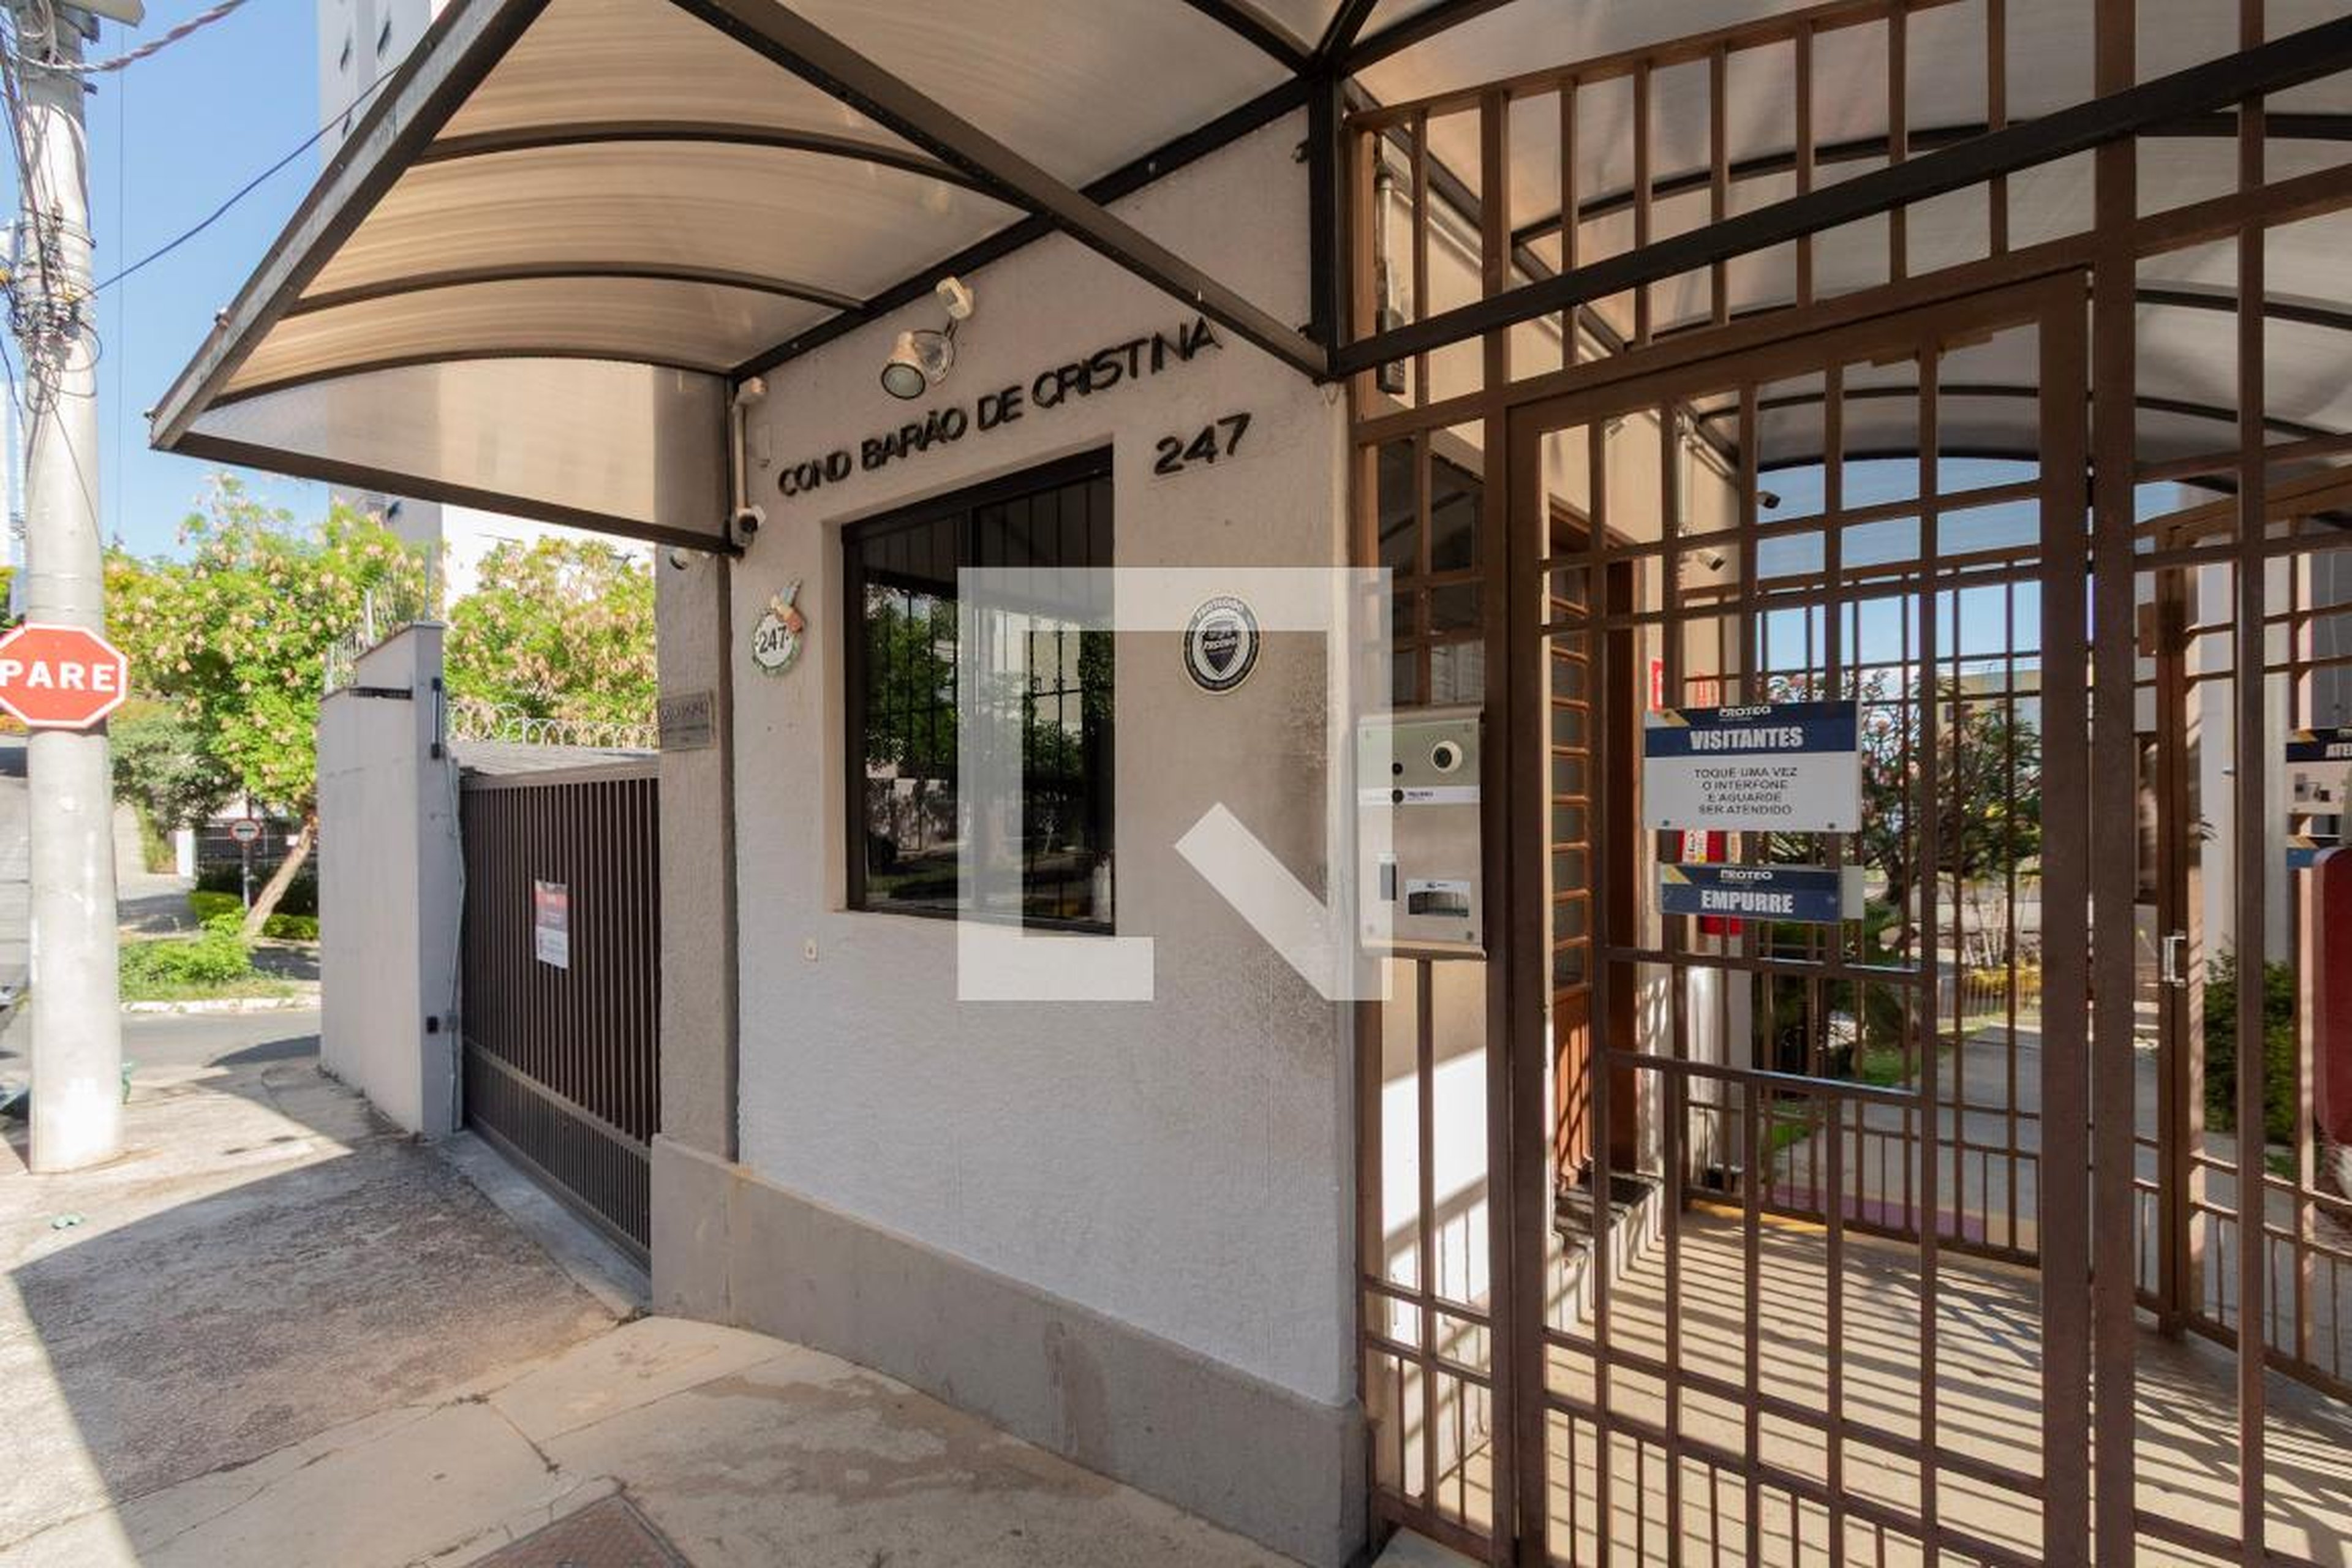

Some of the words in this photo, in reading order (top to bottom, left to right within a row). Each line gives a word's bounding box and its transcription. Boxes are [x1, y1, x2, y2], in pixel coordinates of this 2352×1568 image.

[777, 450, 852, 497] COND
[861, 407, 969, 470] BARÃO
[977, 385, 1023, 431] DE
[1031, 316, 1223, 409] CRISTINA
[1154, 412, 1251, 475] 247
[759, 625, 787, 654] 247
[0, 659, 115, 692] PARE
[1690, 726, 1804, 750] VISITANTES
[1694, 769, 1736, 779] TOQUE
[1740, 767, 1769, 778] UMA
[1772, 767, 1798, 777] VEZ
[1702, 782, 1712, 791] O
[1715, 780, 1789, 790] INTERFONE
[1698, 805, 1723, 815] SER
[1727, 804, 1793, 815] ATENDIDO
[1719, 793, 1782, 803] AGUARDE
[1720, 869, 1773, 880] PROTEO
[1700, 889, 1794, 914] EMPURRE
